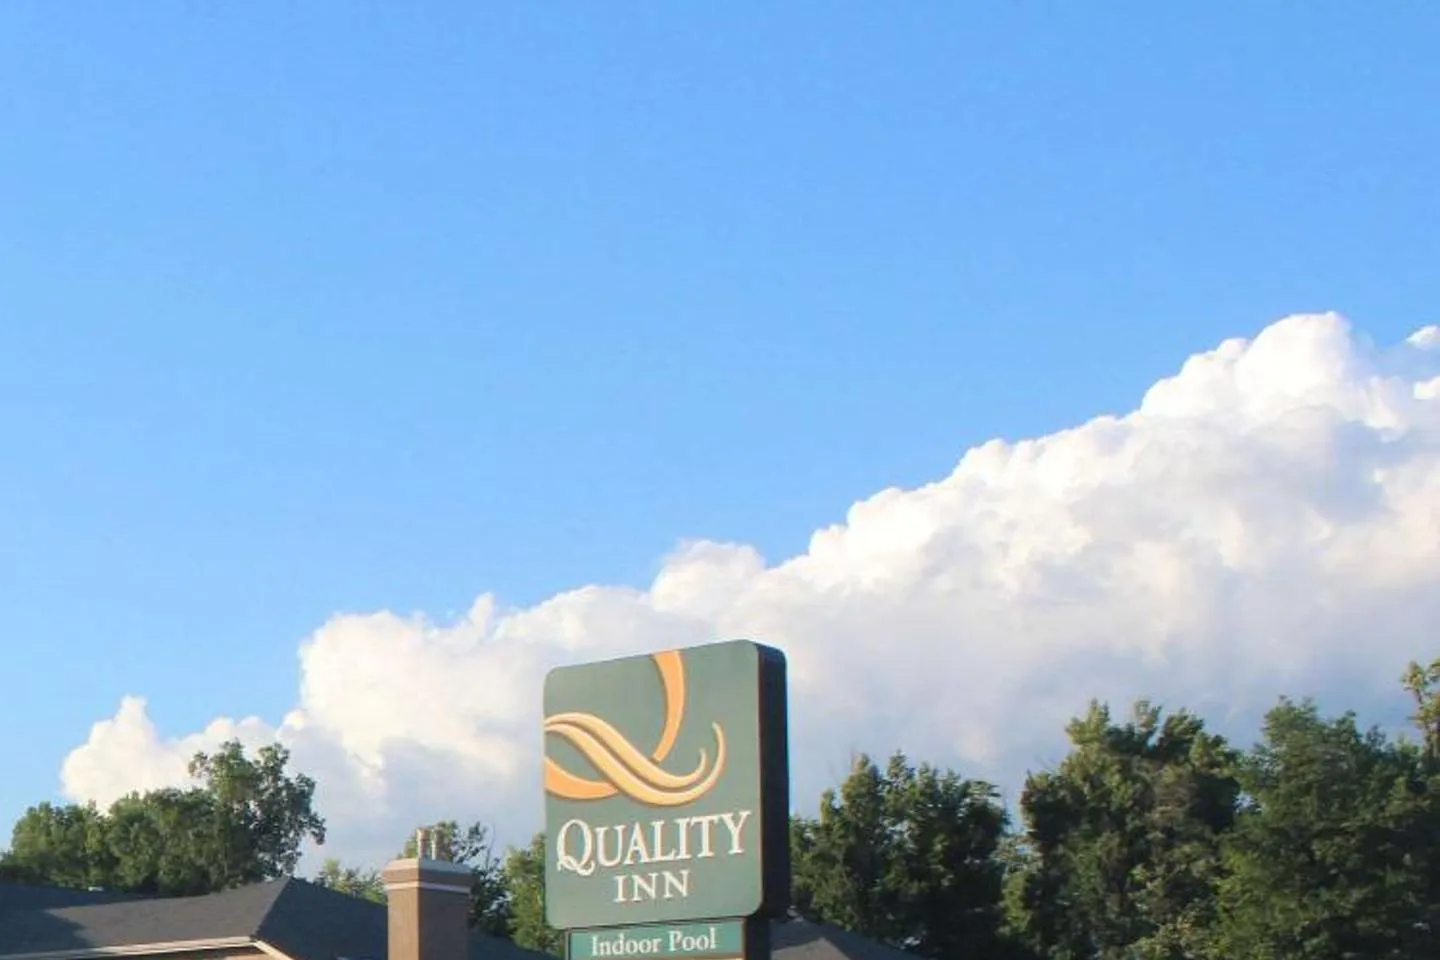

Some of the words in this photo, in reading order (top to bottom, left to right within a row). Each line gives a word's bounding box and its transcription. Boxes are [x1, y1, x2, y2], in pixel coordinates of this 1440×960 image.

[556, 810, 752, 876] QUALITY
[613, 869, 690, 902] INN
[591, 932, 662, 957] Indoor
[668, 927, 716, 952] Pool
